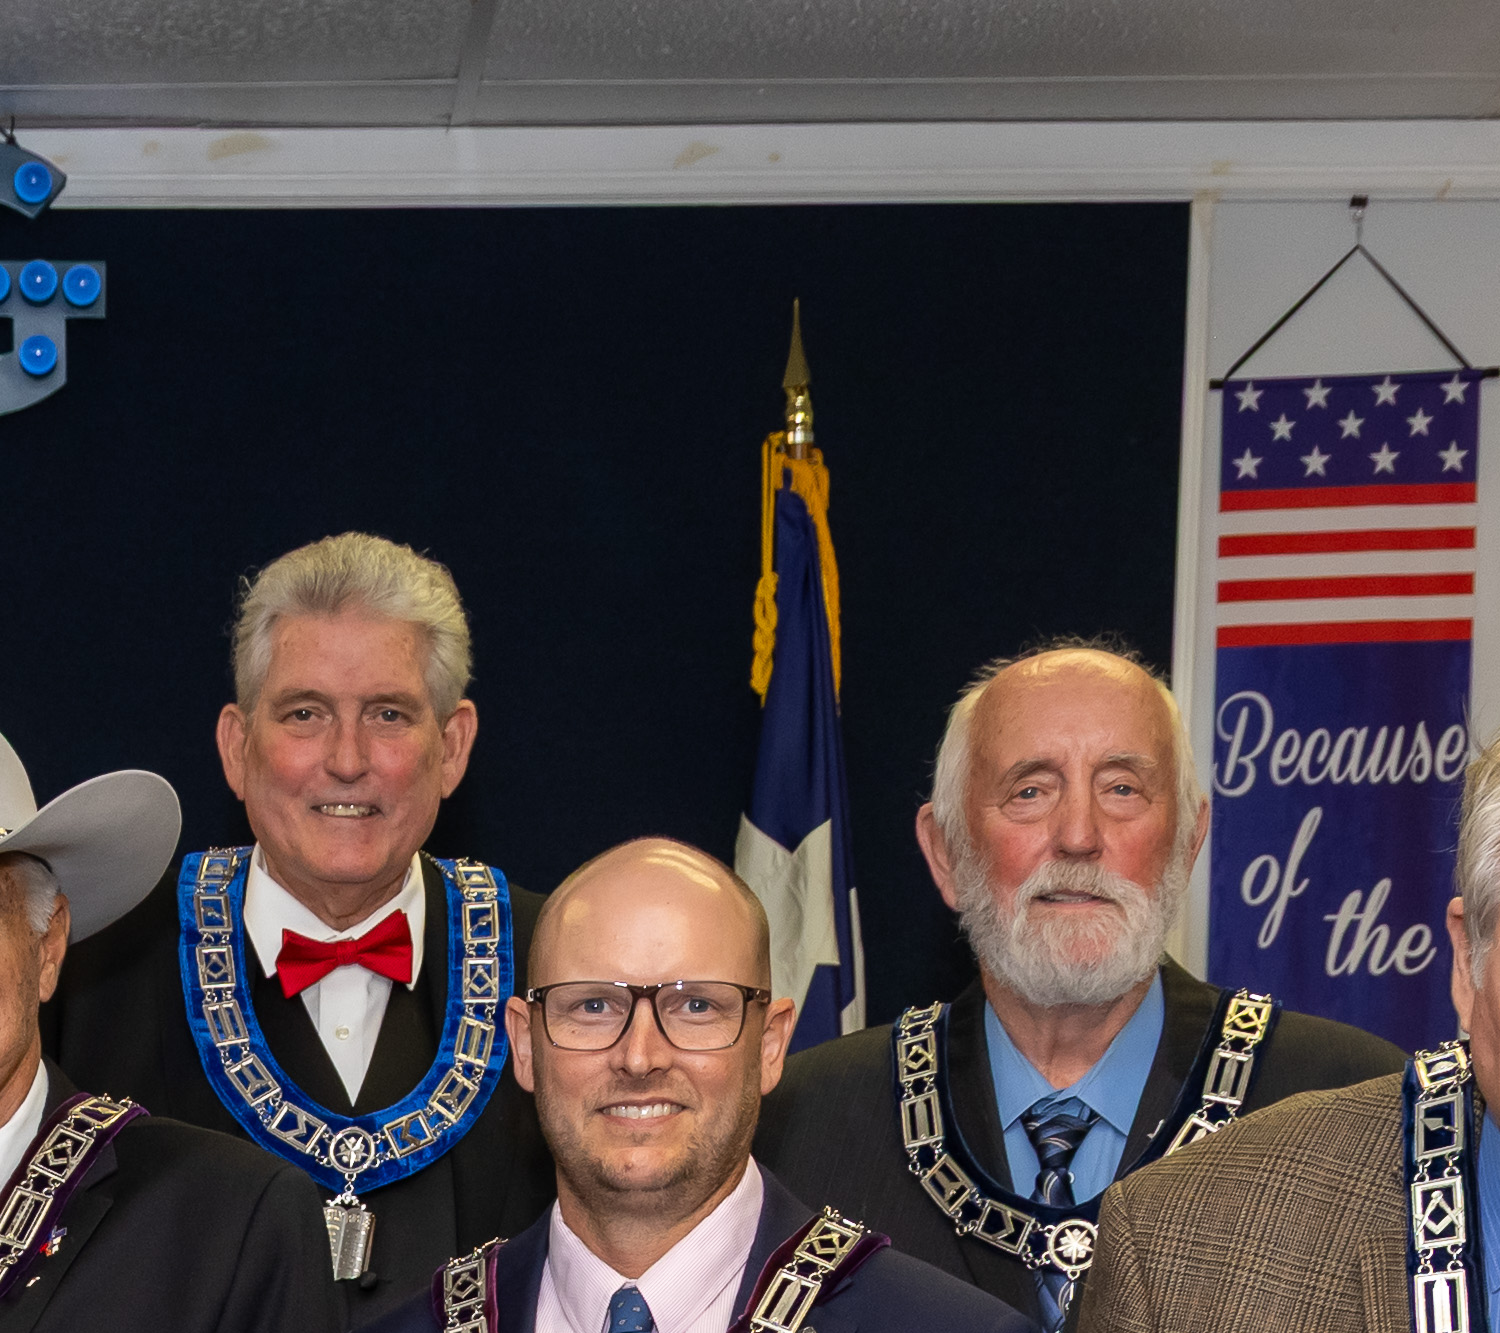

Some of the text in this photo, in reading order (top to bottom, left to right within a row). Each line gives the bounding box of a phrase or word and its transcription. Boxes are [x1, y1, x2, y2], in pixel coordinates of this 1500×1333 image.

[1211, 691, 1470, 797] Because
[1241, 806, 1323, 949] of
[1324, 878, 1437, 977] the
